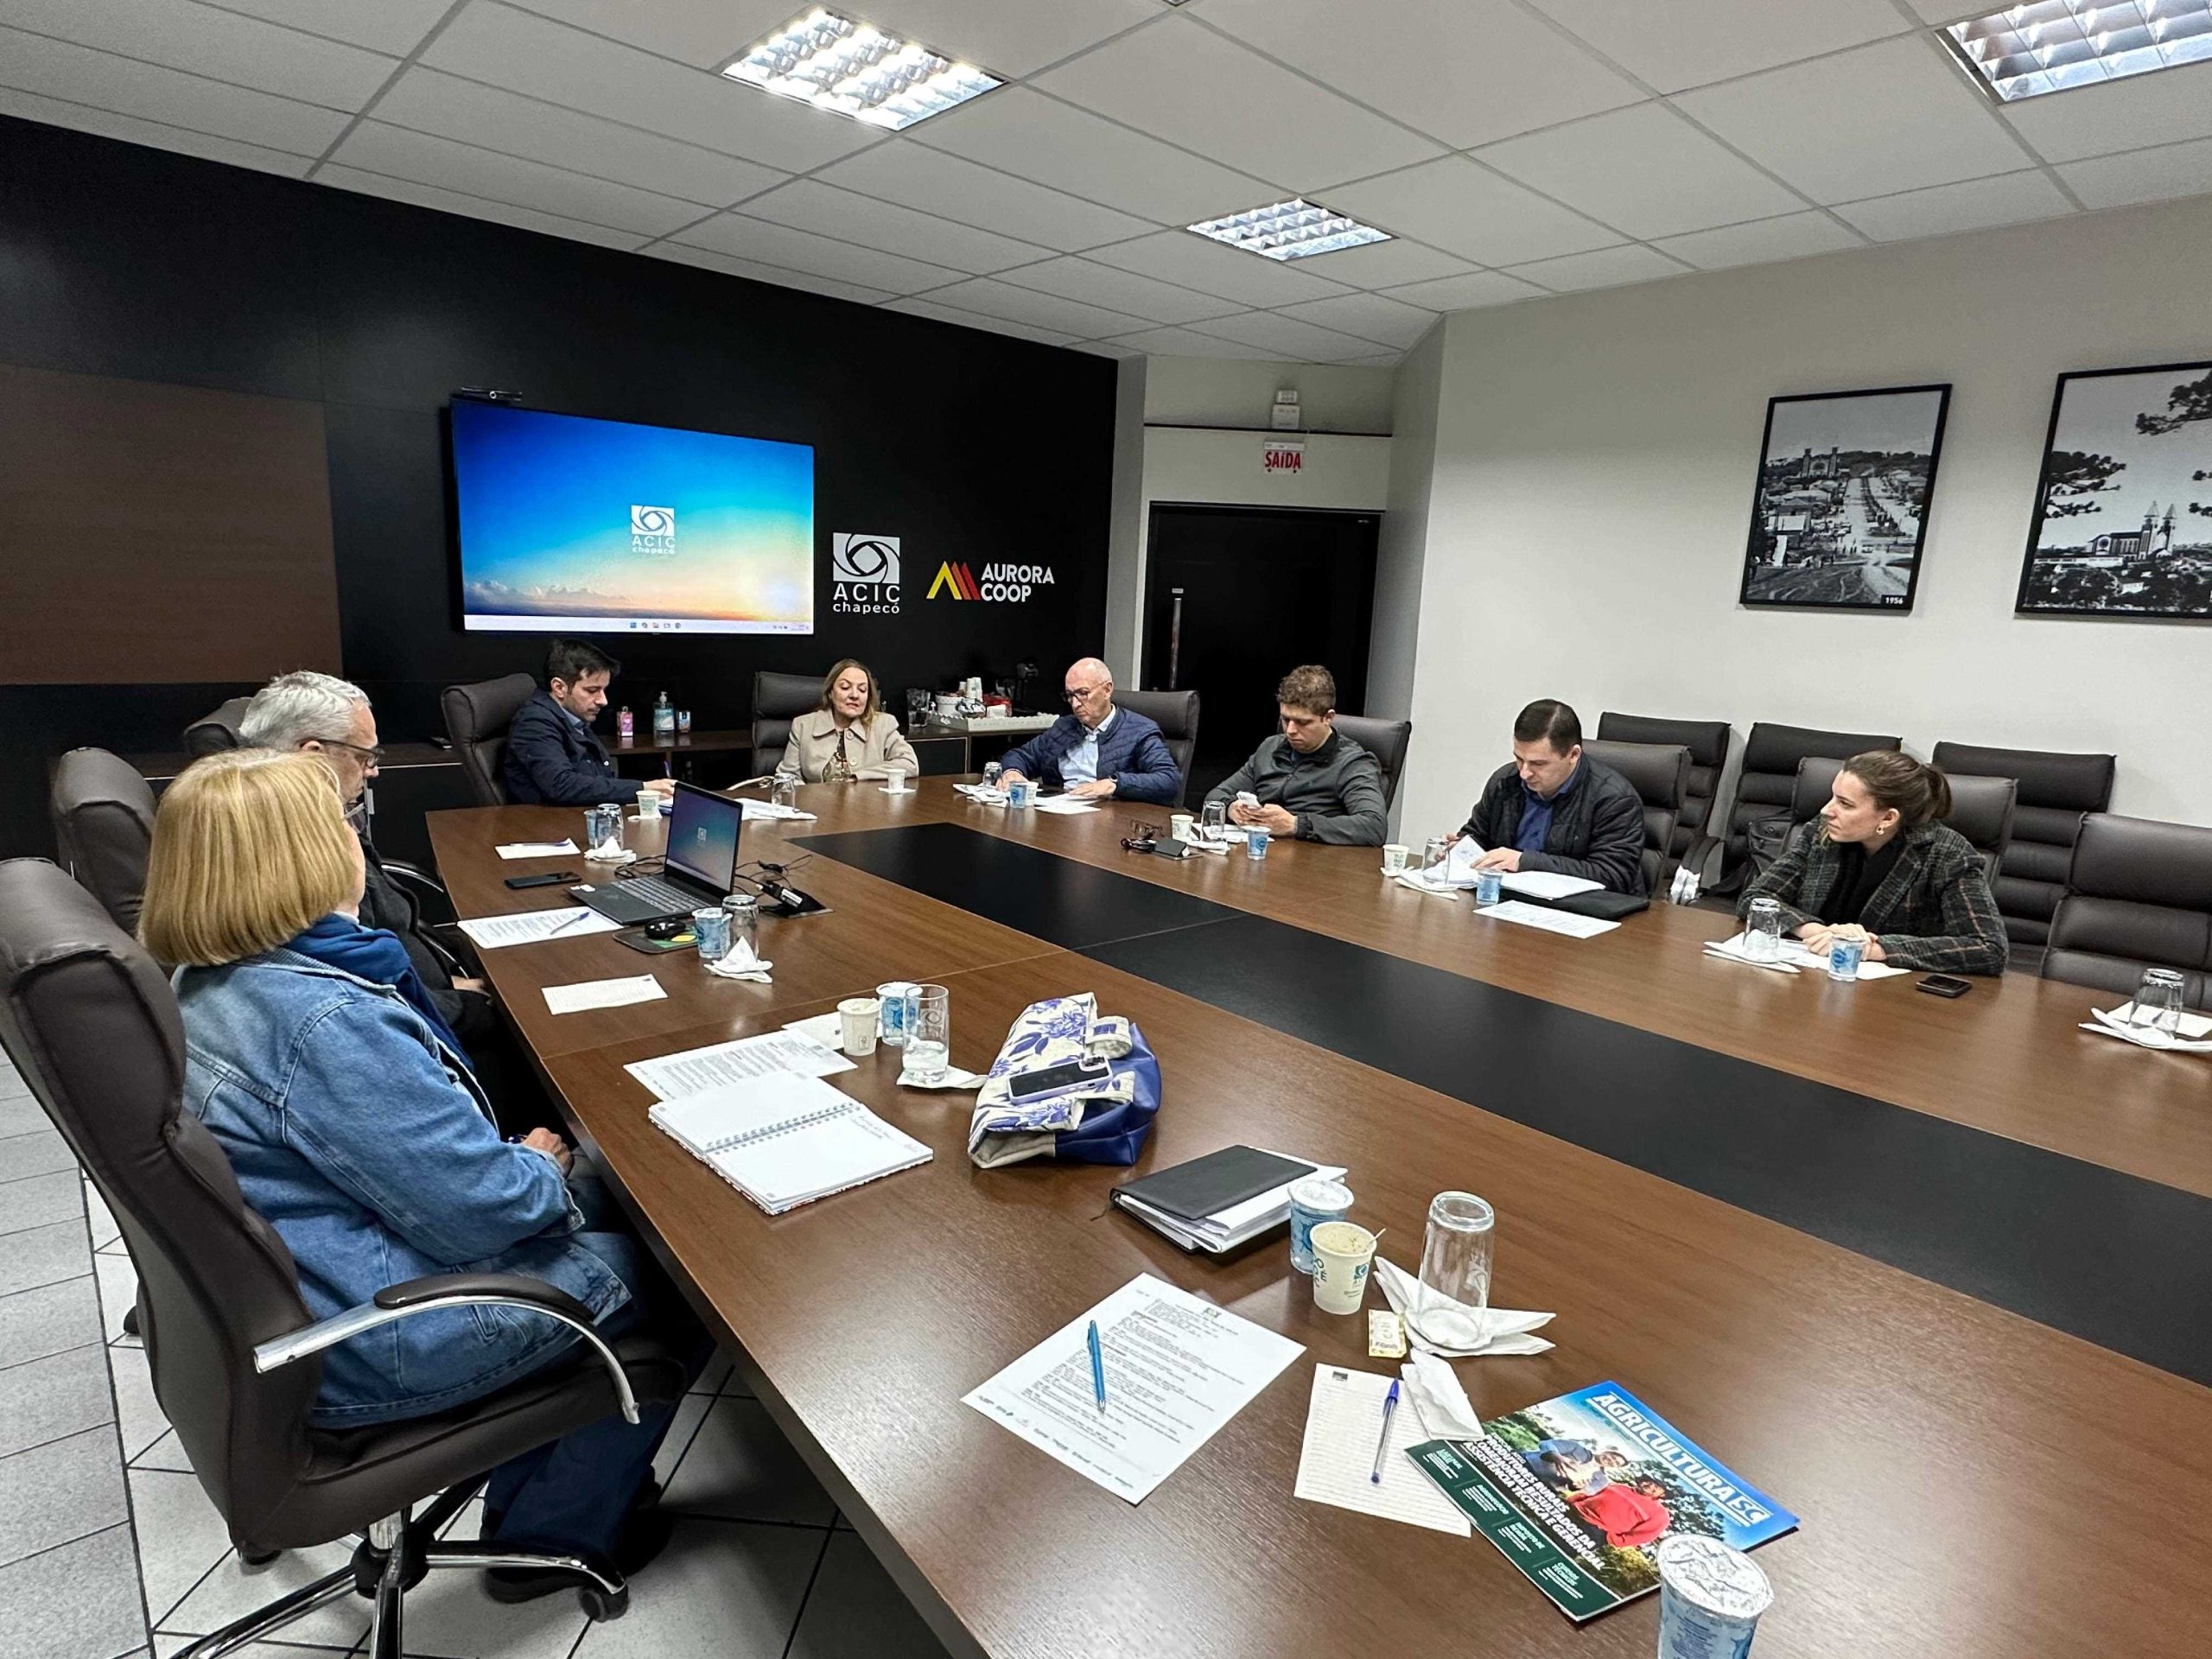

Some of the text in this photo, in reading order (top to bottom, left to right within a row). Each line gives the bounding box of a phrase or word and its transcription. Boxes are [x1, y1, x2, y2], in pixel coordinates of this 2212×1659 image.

[632, 535, 676, 548] ACIC
[981, 563, 1055, 585] AURORA
[833, 583, 900, 603] ACIC
[981, 583, 1032, 602] COOP
[833, 601, 900, 614] chapecó
[1885, 596, 1904, 605] 1956
[1576, 1534, 1597, 1548] DA
